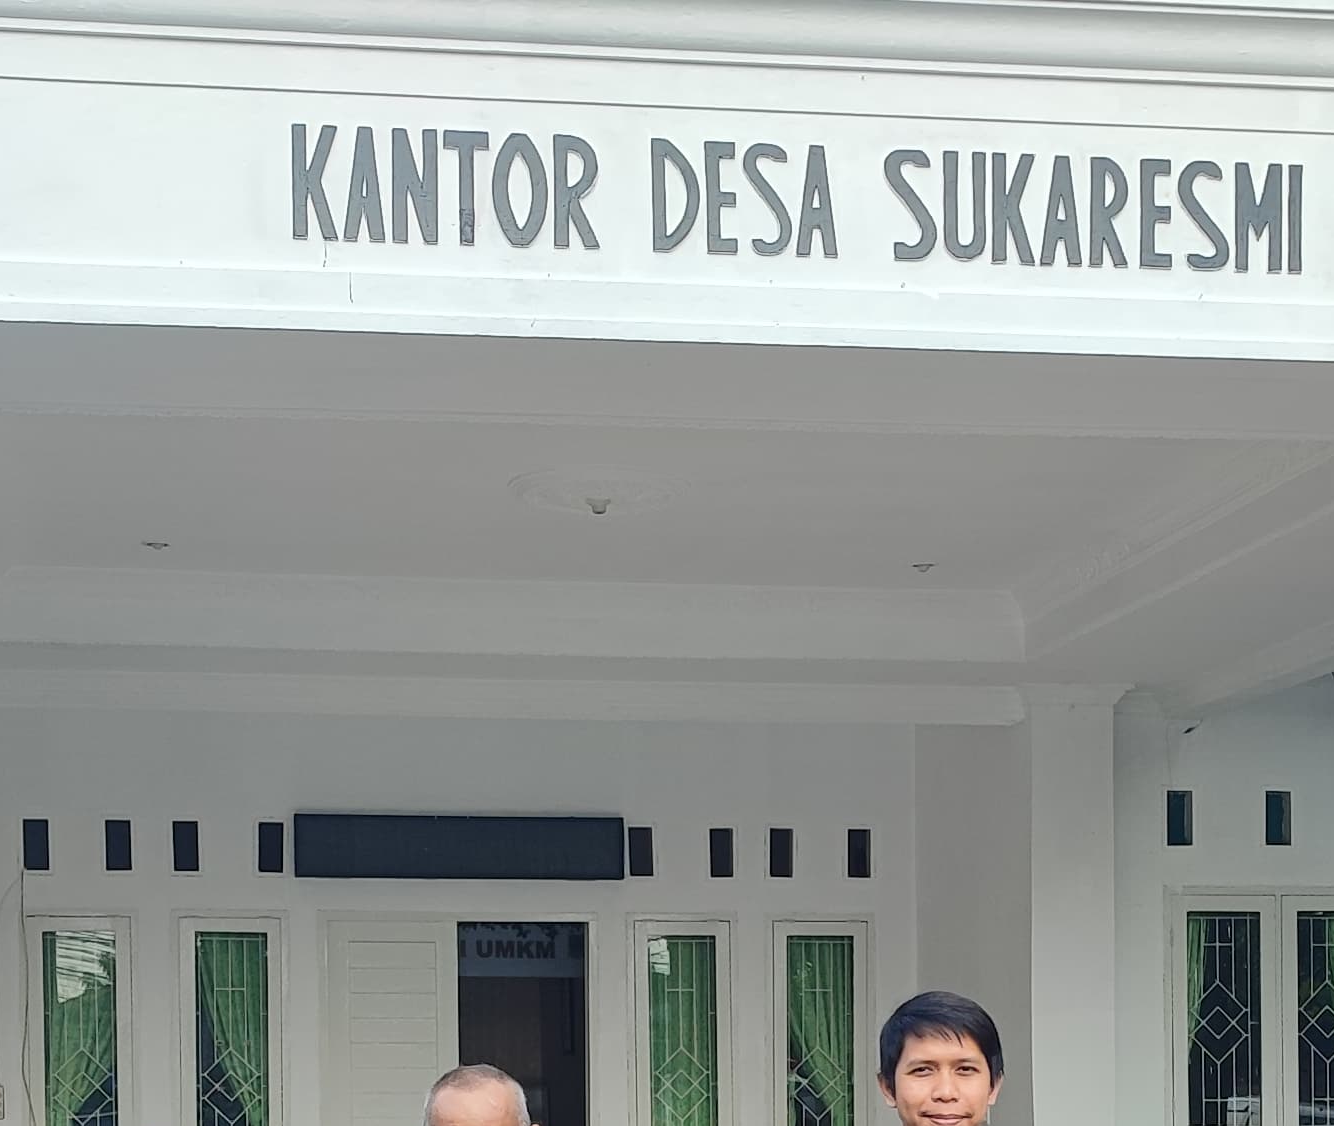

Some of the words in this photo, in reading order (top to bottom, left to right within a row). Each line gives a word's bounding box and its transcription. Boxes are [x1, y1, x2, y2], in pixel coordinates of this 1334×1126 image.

[291, 123, 599, 252] KANTOR
[650, 138, 838, 259] DESA
[882, 149, 1303, 275] SUKARESMI
[476, 939, 556, 959] UMKM
